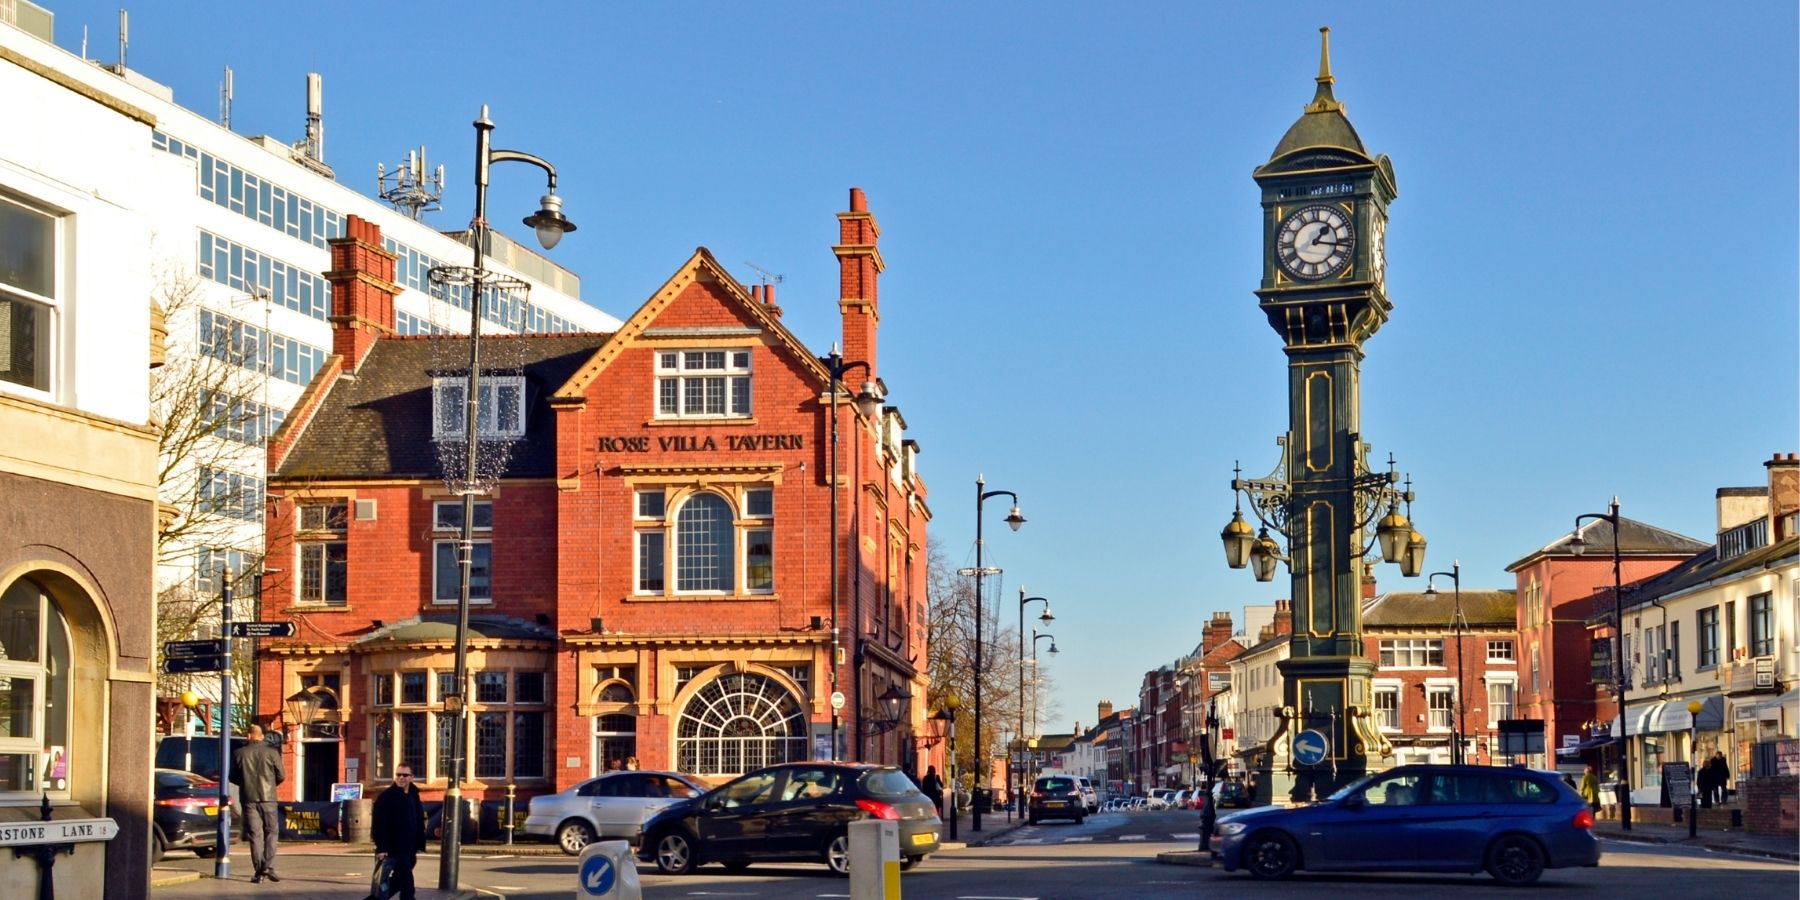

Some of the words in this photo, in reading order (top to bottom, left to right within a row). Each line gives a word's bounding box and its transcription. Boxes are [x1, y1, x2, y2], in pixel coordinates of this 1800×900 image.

[599, 436, 649, 452] ROSE
[658, 435, 717, 452] VILLA
[725, 434, 803, 450] TAVERN
[301, 811, 320, 819] VILLA
[285, 819, 320, 830] TAVERN
[62, 825, 93, 837] LANE
